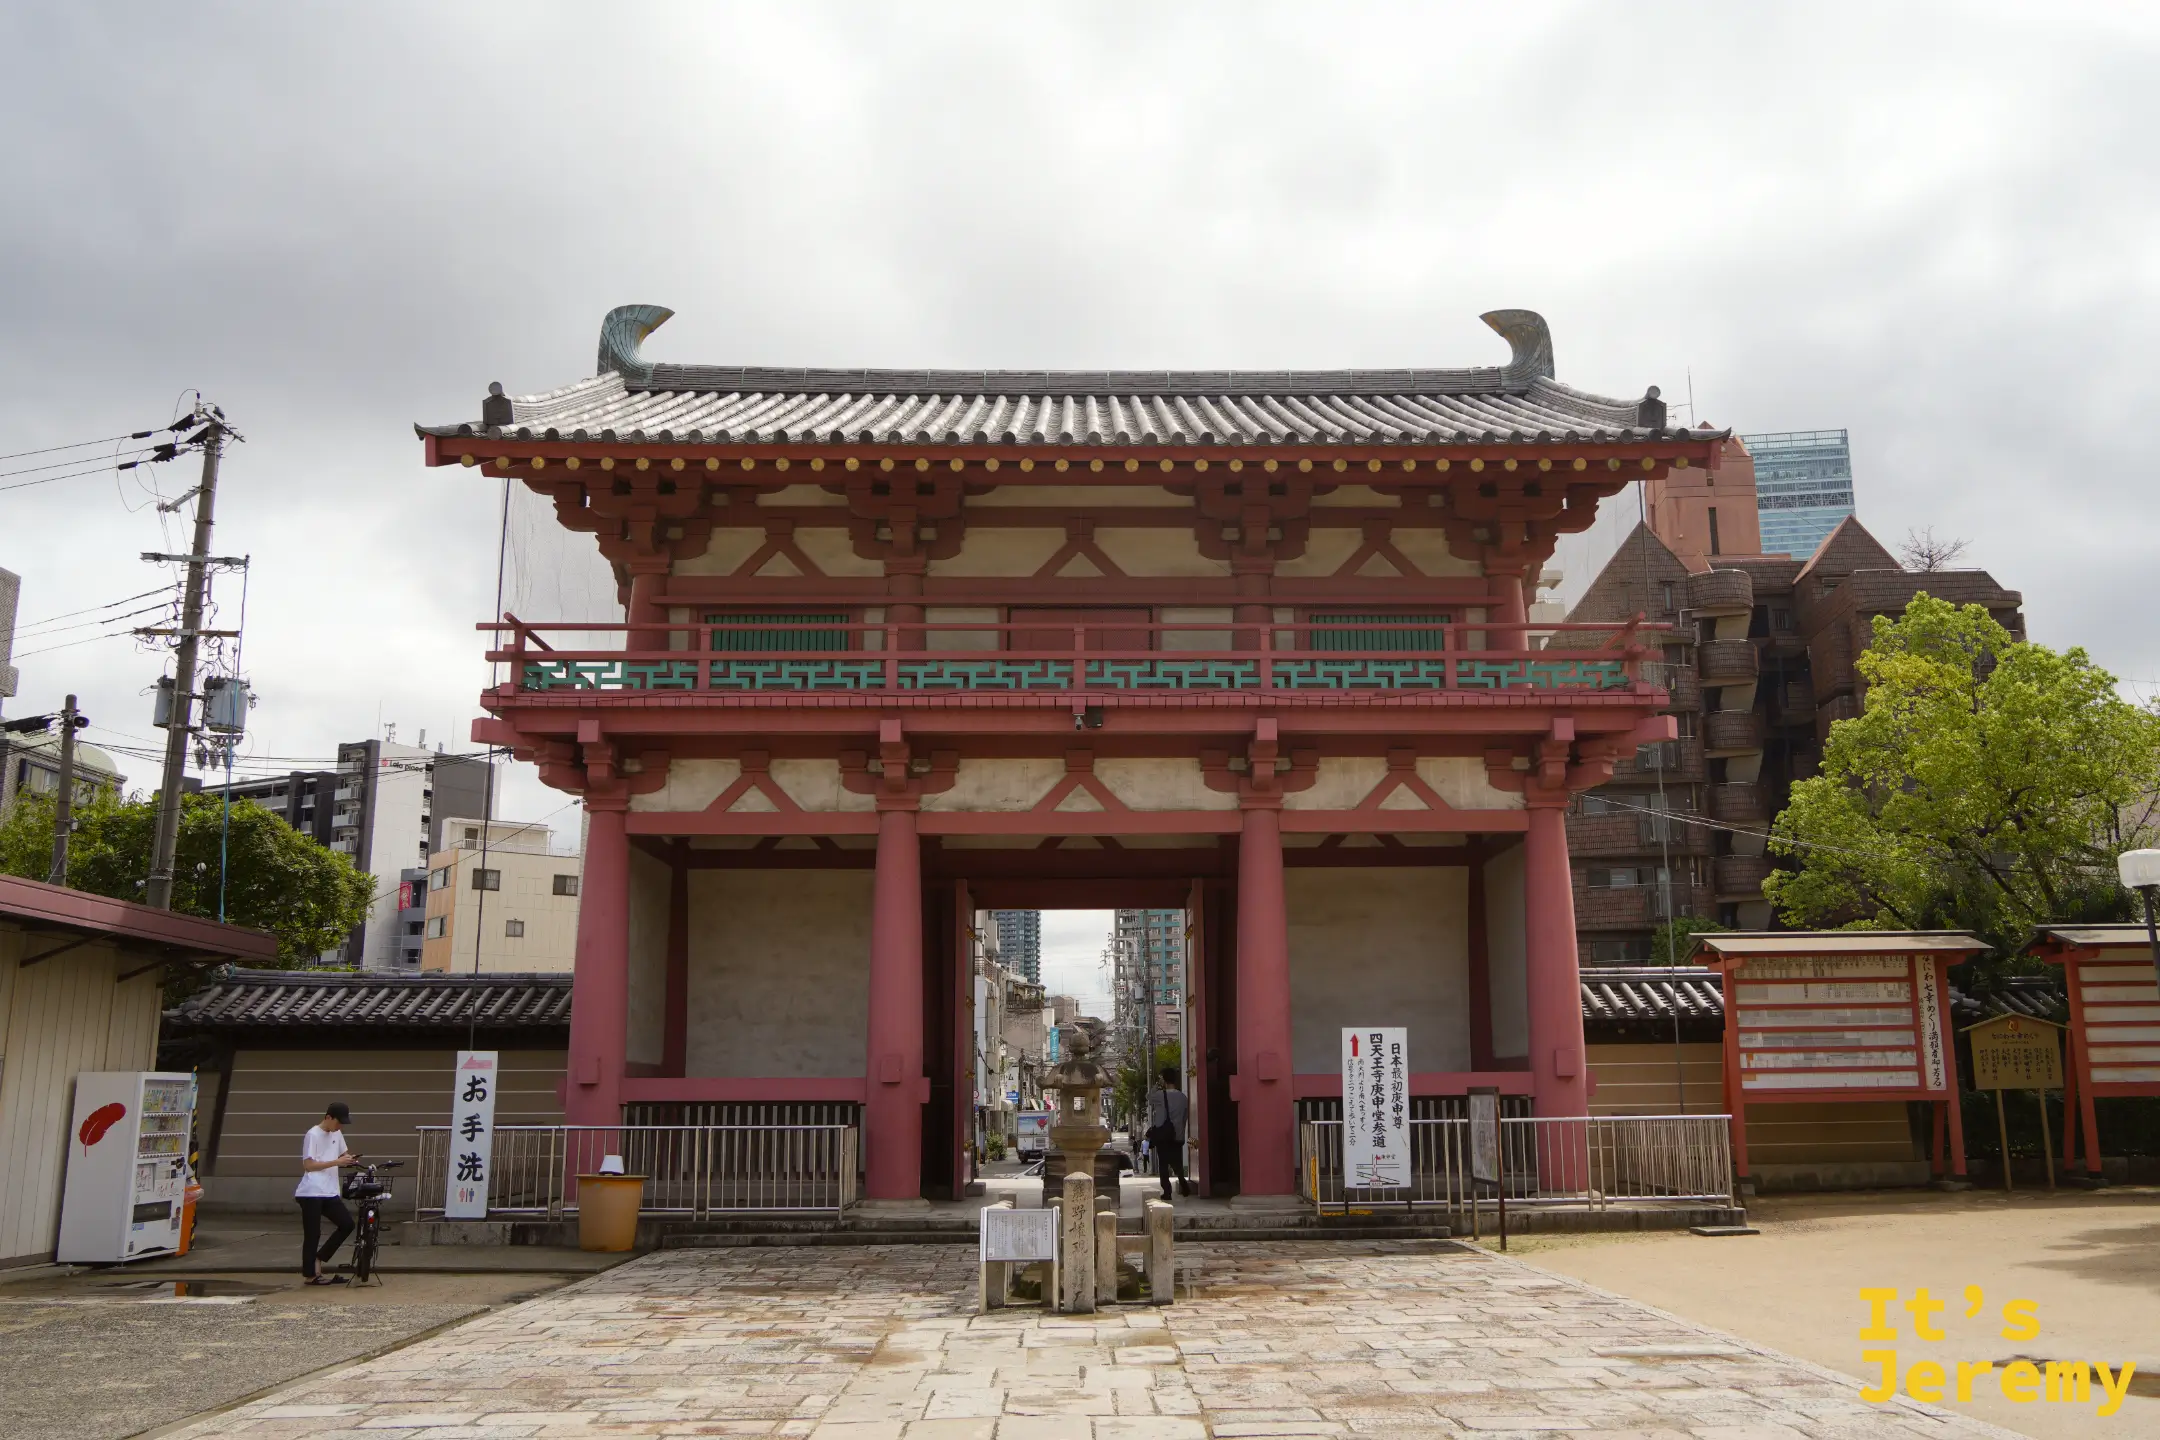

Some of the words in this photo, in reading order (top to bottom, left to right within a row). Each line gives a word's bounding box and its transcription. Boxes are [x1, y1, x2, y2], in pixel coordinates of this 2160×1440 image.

[456, 1075, 487, 1182] お手洗
[1370, 1033, 1387, 1148] 四天王寺庚申堂参道
[1390, 1043, 1404, 1129] 日本最初庚申尊
